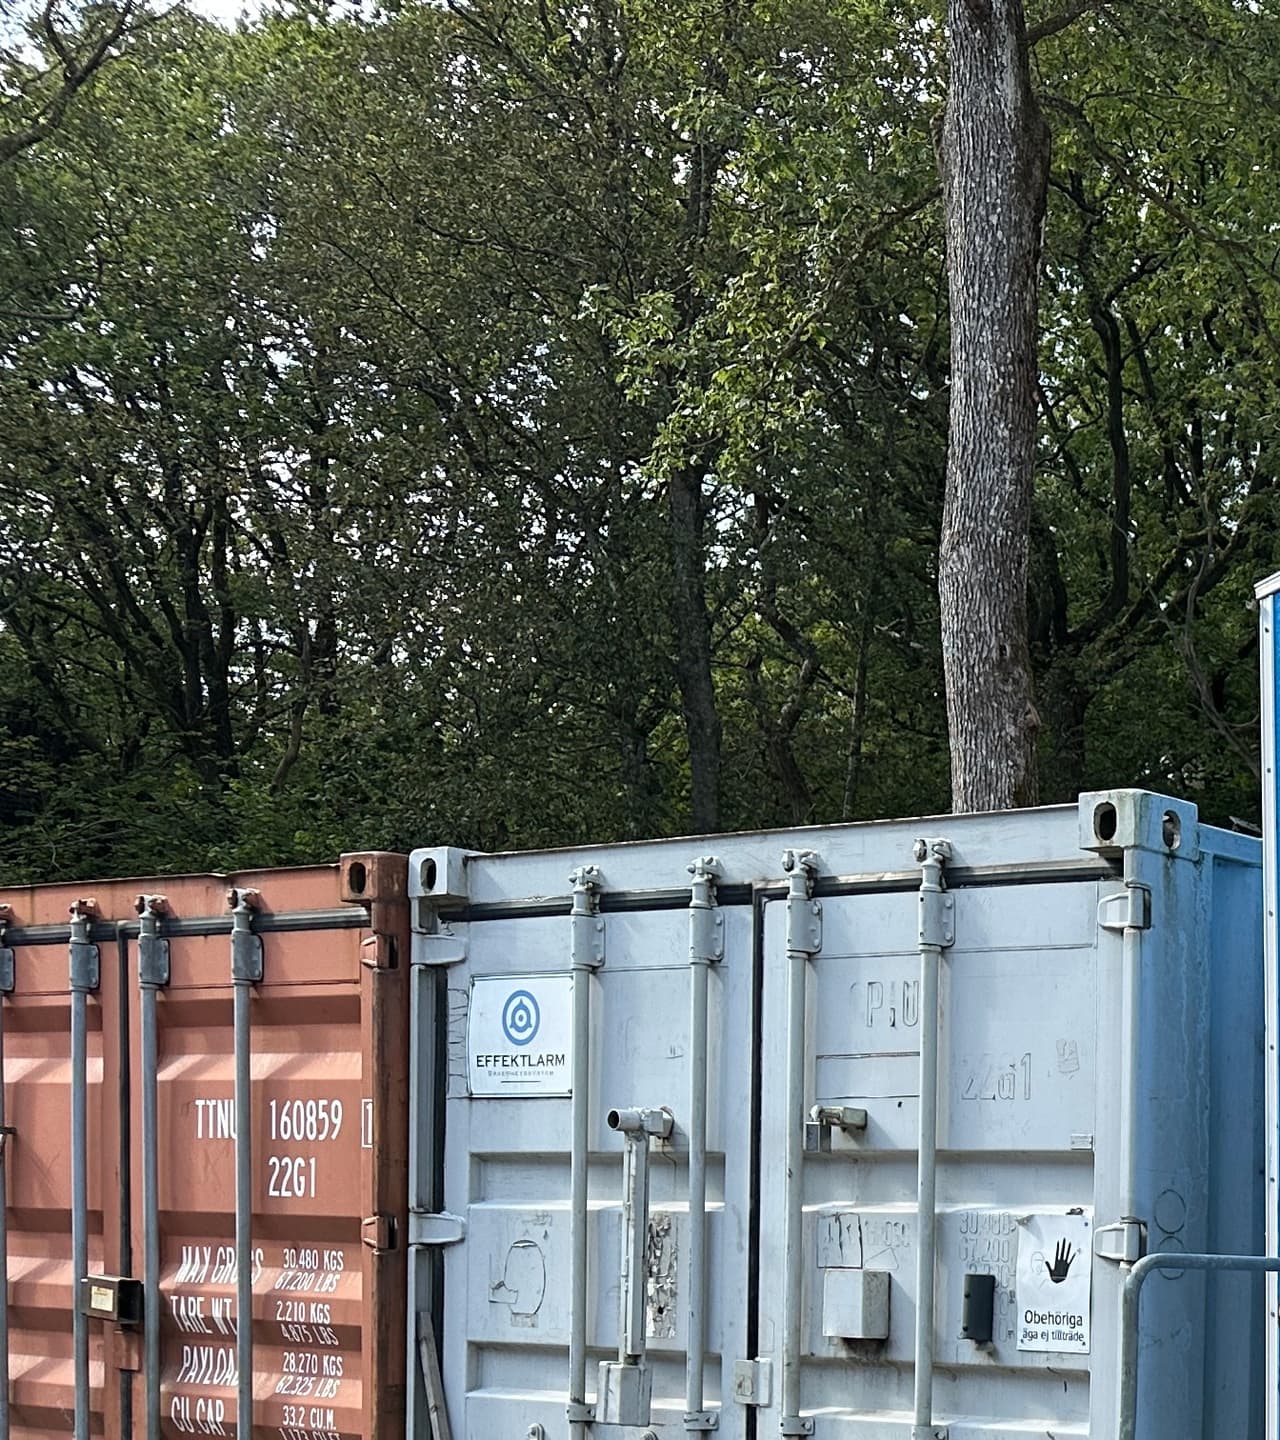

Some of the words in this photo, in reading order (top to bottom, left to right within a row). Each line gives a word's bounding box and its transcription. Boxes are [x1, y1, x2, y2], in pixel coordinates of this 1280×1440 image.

[476, 1054, 565, 1067] EFFEKTLARM
[269, 1099, 343, 1141] 160859
[363, 1101, 373, 1145] 1
[268, 1156, 316, 1198] 22G1
[175, 1246, 211, 1283] MAX
[211, 1247, 264, 1285] GRS
[283, 1248, 318, 1270] 30.480
[323, 1250, 344, 1271] KGS
[275, 1271, 315, 1291] 67.200
[314, 1273, 340, 1292] LBS
[170, 1296, 213, 1334] TARE
[276, 1301, 306, 1321] 2.210
[310, 1303, 331, 1324] KGS
[1024, 1310, 1083, 1329] Obehöriga
[312, 1325, 339, 1346] LBS
[1041, 1330, 1049, 1342] ej
[283, 1352, 318, 1374] 28.270
[323, 1355, 343, 1376] KGS
[275, 1376, 316, 1396] 62.325
[314, 1378, 340, 1398] LBS
[282, 1405, 306, 1427] 33.2
